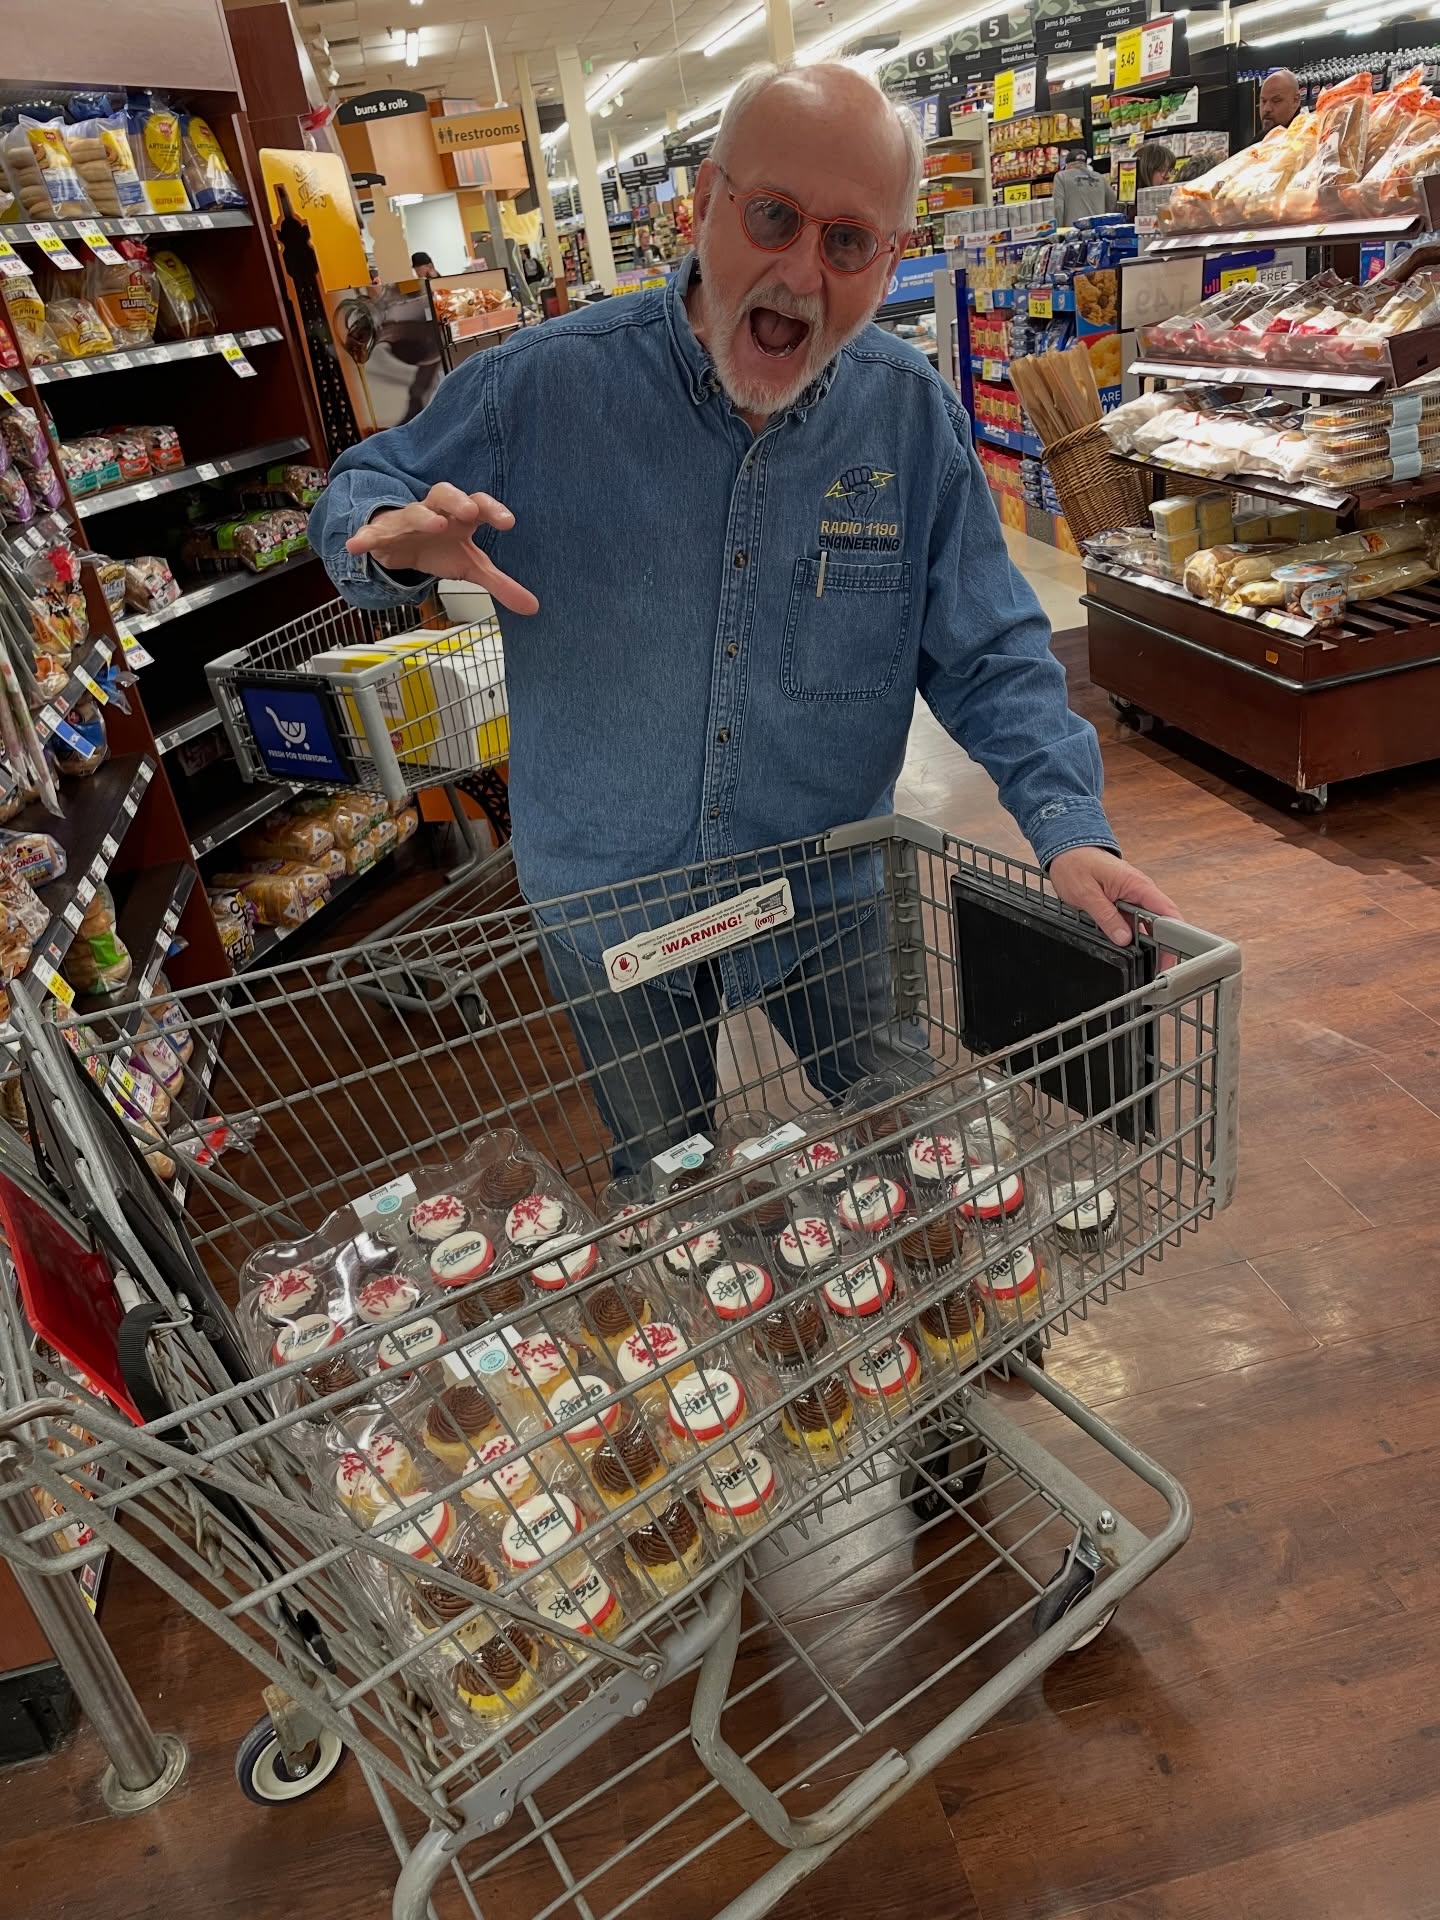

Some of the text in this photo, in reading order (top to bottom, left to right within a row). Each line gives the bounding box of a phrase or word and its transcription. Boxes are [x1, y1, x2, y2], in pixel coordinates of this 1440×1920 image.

[1105, 6, 1130, 17] crackers
[988, 19, 1000, 38] 5
[1044, 15, 1082, 30] jams & jellies
[1107, 18, 1130, 28] cookies
[1056, 29, 1070, 38] nuts
[1001, 45, 1022, 54] pancake
[1054, 39, 1073, 49] candy
[1147, 40, 1164, 58] 2.49
[915, 51, 927, 68] 6
[1120, 51, 1136, 68] 5.49
[355, 98, 409, 116] buns & rolls
[455, 122, 521, 143] restrooms
[634, 153, 647, 166] 11
[1009, 191, 1028, 201] 4.79
[1261, 270, 1288, 281] FREE
[1034, 302, 1046, 314] 5.29
[820, 520, 897, 536] RADIO 1190
[818, 535, 900, 551] ENGINEERING
[268, 749, 285, 759] FRESH
[285, 751, 298, 761] FOR
[661, 913, 742, 955] !WARNING!
